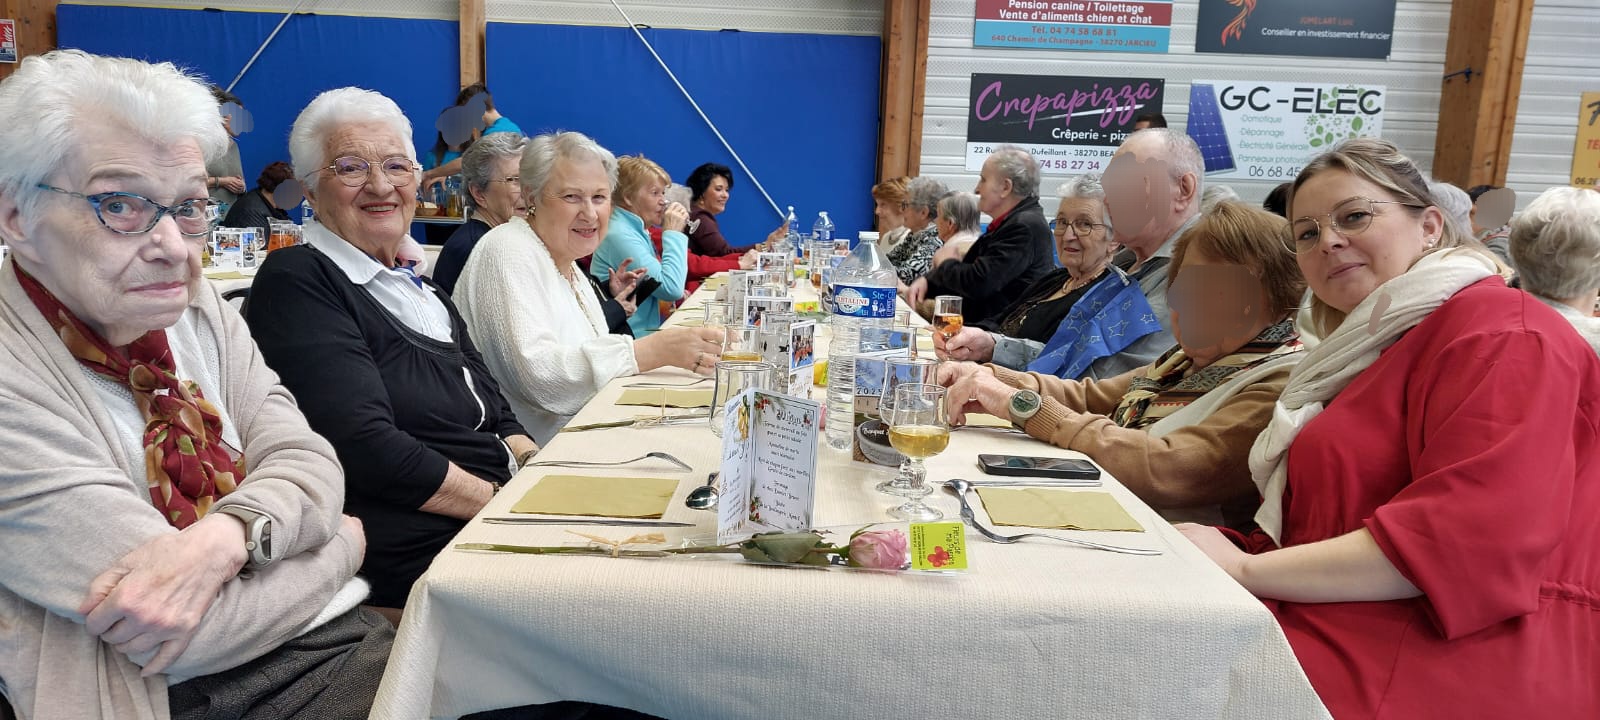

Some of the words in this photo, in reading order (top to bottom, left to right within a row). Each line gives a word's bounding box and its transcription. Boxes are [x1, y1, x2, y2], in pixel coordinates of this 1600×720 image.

[1008, 0, 1048, 10] Pension
[1051, 1, 1085, 12] canine
[1094, 2, 1145, 14] Toilettage
[999, 9, 1029, 20] Vente
[1031, 10, 1084, 22] d'aliments
[1086, 12, 1115, 23] chien
[1117, 14, 1128, 24] et
[1130, 14, 1152, 24] chat
[1064, 27, 1076, 35] 74
[1261, 27, 1296, 37] Conseiller
[1307, 29, 1359, 39] investissement
[1360, 30, 1391, 40] financier
[1007, 35, 1036, 43] Chemin
[1049, 36, 1093, 46] Champagne
[975, 80, 1158, 132] Crepapizza
[1051, 127, 1099, 142] Crêperie
[1109, 129, 1129, 143] piz
[985, 146, 996, 154] Ru
[1587, 139, 1600, 151] TE
[1031, 147, 1067, 156] Dufeillant
[1074, 149, 1098, 157] 38270
[1099, 150, 1115, 158] BEA
[1039, 159, 1051, 169] 74
[1055, 160, 1067, 169] 58
[1071, 160, 1084, 170] 27
[1087, 160, 1100, 170] 34
[1249, 165, 1264, 177] 06
[1267, 166, 1282, 177] 68
[1286, 167, 1301, 177] 45
